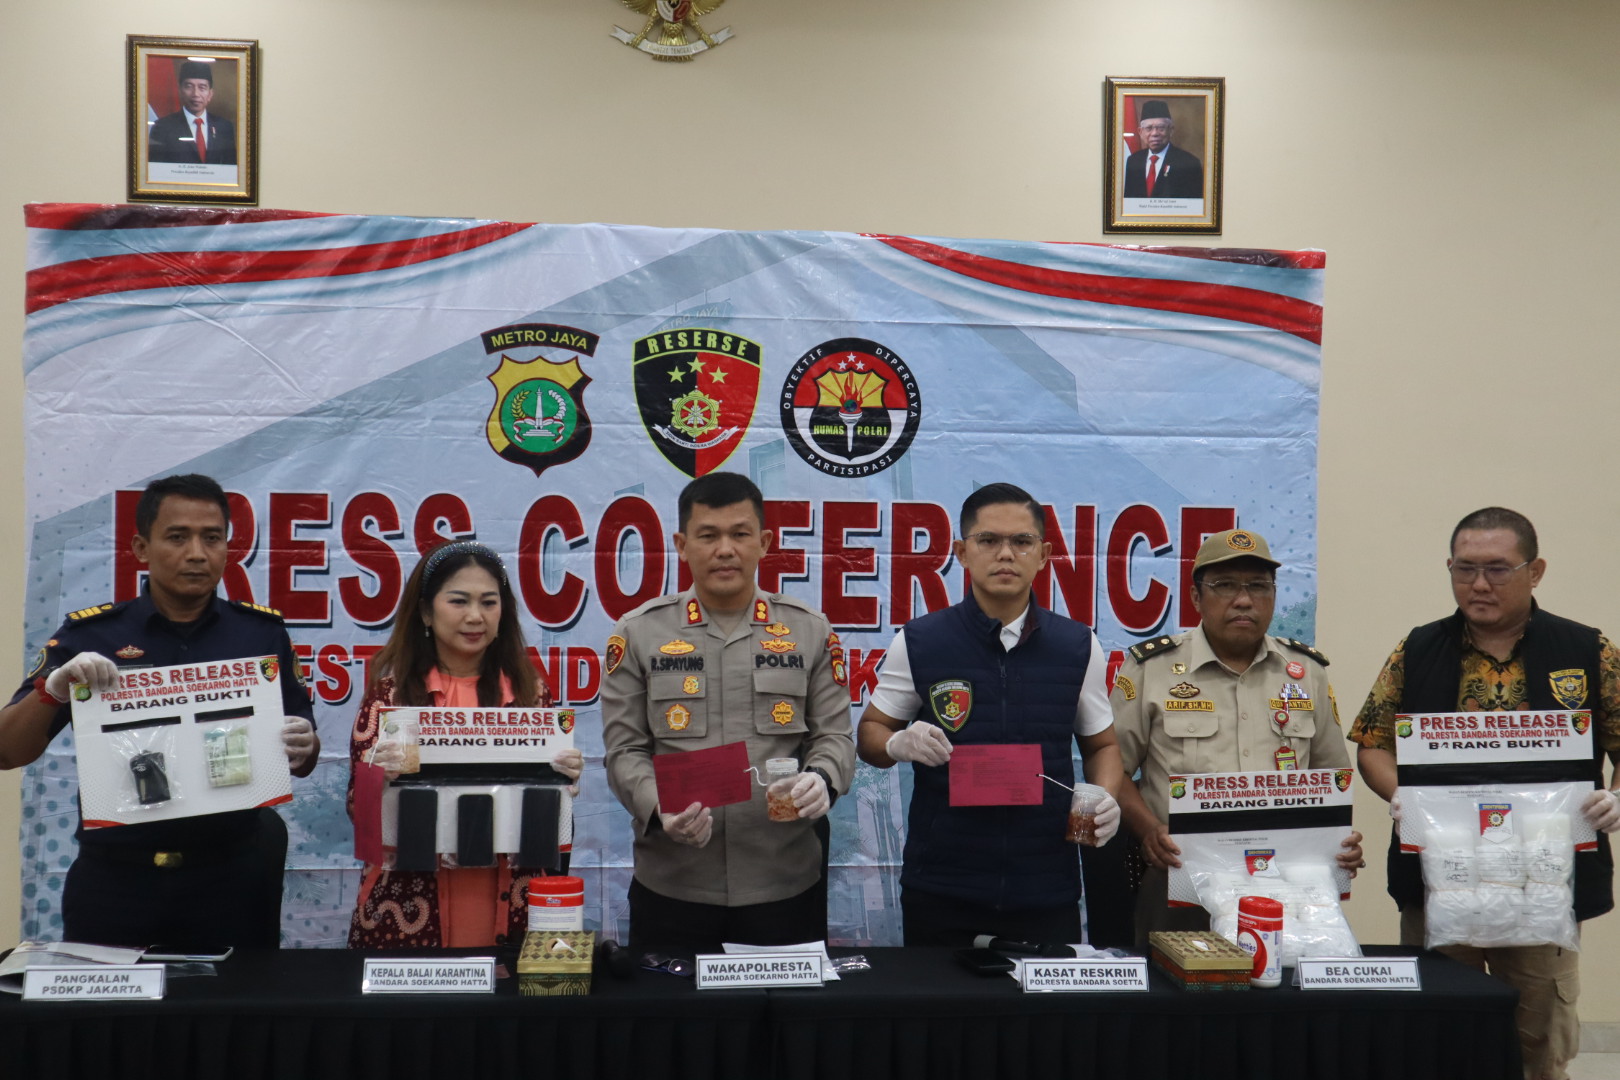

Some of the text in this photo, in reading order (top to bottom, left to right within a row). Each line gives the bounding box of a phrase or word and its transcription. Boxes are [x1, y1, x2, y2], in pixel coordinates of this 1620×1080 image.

[491, 330, 587, 350] METRO JAYA
[647, 331, 748, 356] RESERSE
[783, 348, 823, 410] OBYEKTIF
[875, 347, 918, 418] DIPERCAYA
[813, 425, 887, 436] HUMAS POLRI
[807, 453, 893, 475] PARTISIPASI
[755, 654, 804, 669] POLRI
[169, 661, 257, 684] RELEASE
[101, 677, 259, 703] POLRESTA BANDARA SOEKARNO HATTA
[111, 689, 251, 712] BARANG BUKTI
[418, 711, 555, 726] RESS RELEASE
[1420, 713, 1569, 731] PRESS RELEASE
[449, 727, 485, 736] BANDARA
[486, 727, 529, 736] SOEKARNO
[530, 727, 556, 736] HATTA
[1420, 728, 1570, 740] POLRESTA BANDARA SOEKARNO HATTA
[493, 738, 546, 747] BUKTI
[1507, 739, 1561, 749] BUKTI
[1193, 775, 1249, 791] PRESS
[1254, 772, 1333, 789] RELEASE
[1193, 787, 1332, 800] POLRESTA BANDARA SOEKARNO HATTA
[1200, 796, 1324, 810] BARANG BUKTI
[371, 968, 486, 978] KEPALA BALAI KARANTINA
[707, 961, 812, 973] WAKAPOLRESTA
[1034, 968, 1138, 978] KASAT RESKRIM
[1325, 966, 1391, 976] BEA CUKAI
[54, 974, 130, 984] PANGKALAN
[42, 985, 142, 995] PSDKP JAKARTA
